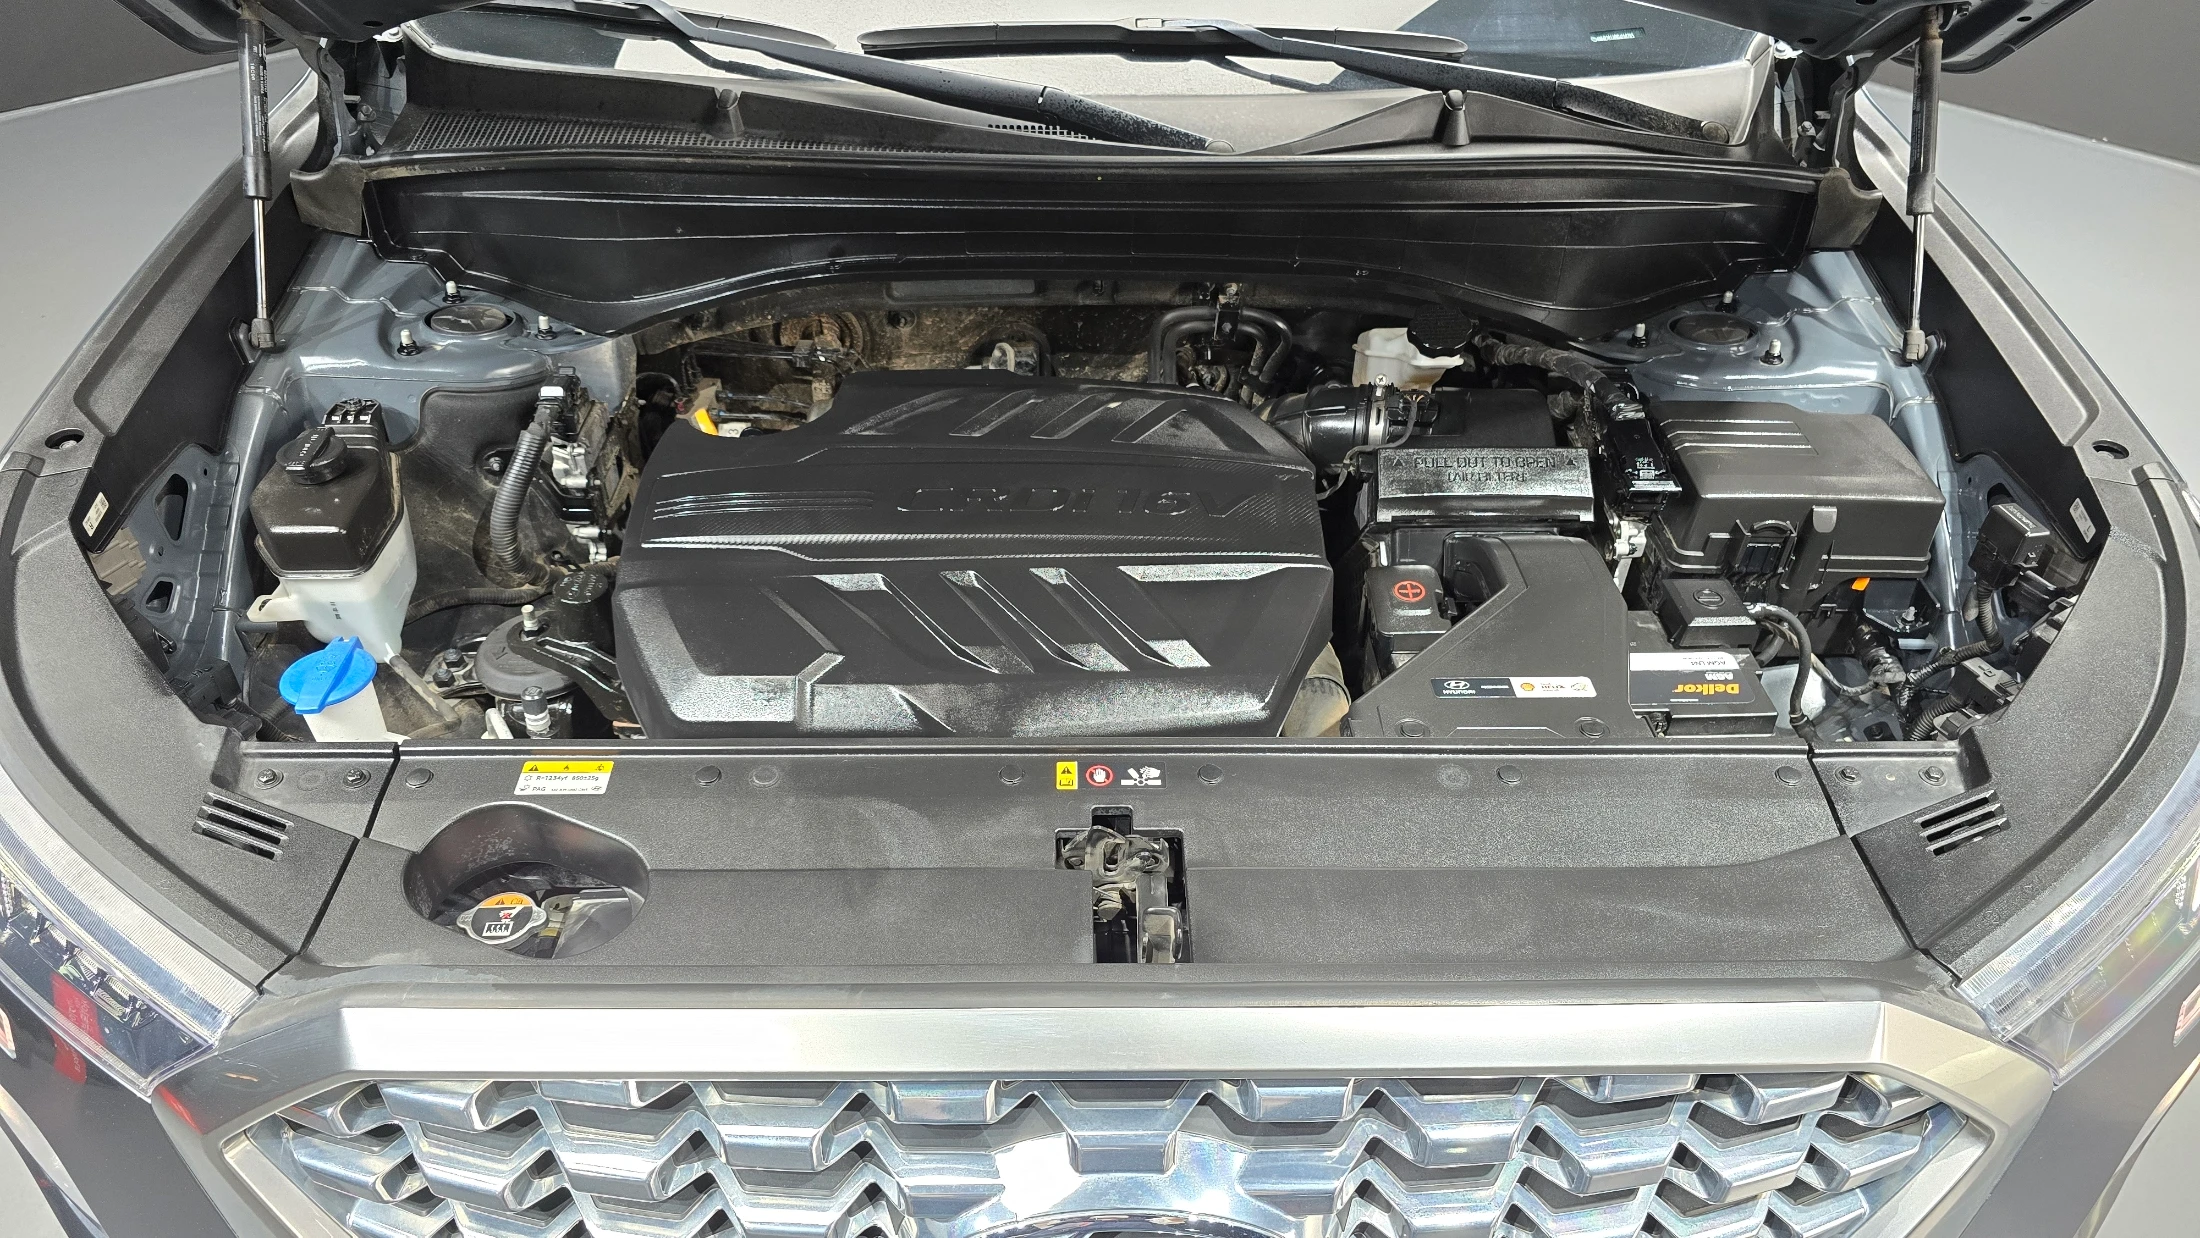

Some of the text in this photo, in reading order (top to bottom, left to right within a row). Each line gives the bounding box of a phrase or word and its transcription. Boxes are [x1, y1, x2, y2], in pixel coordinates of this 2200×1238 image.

[1414, 456, 1557, 468] PULL OUT TO OPEN
[1117, 488, 1257, 518] 16V
[1673, 683, 1739, 695] Delkor
